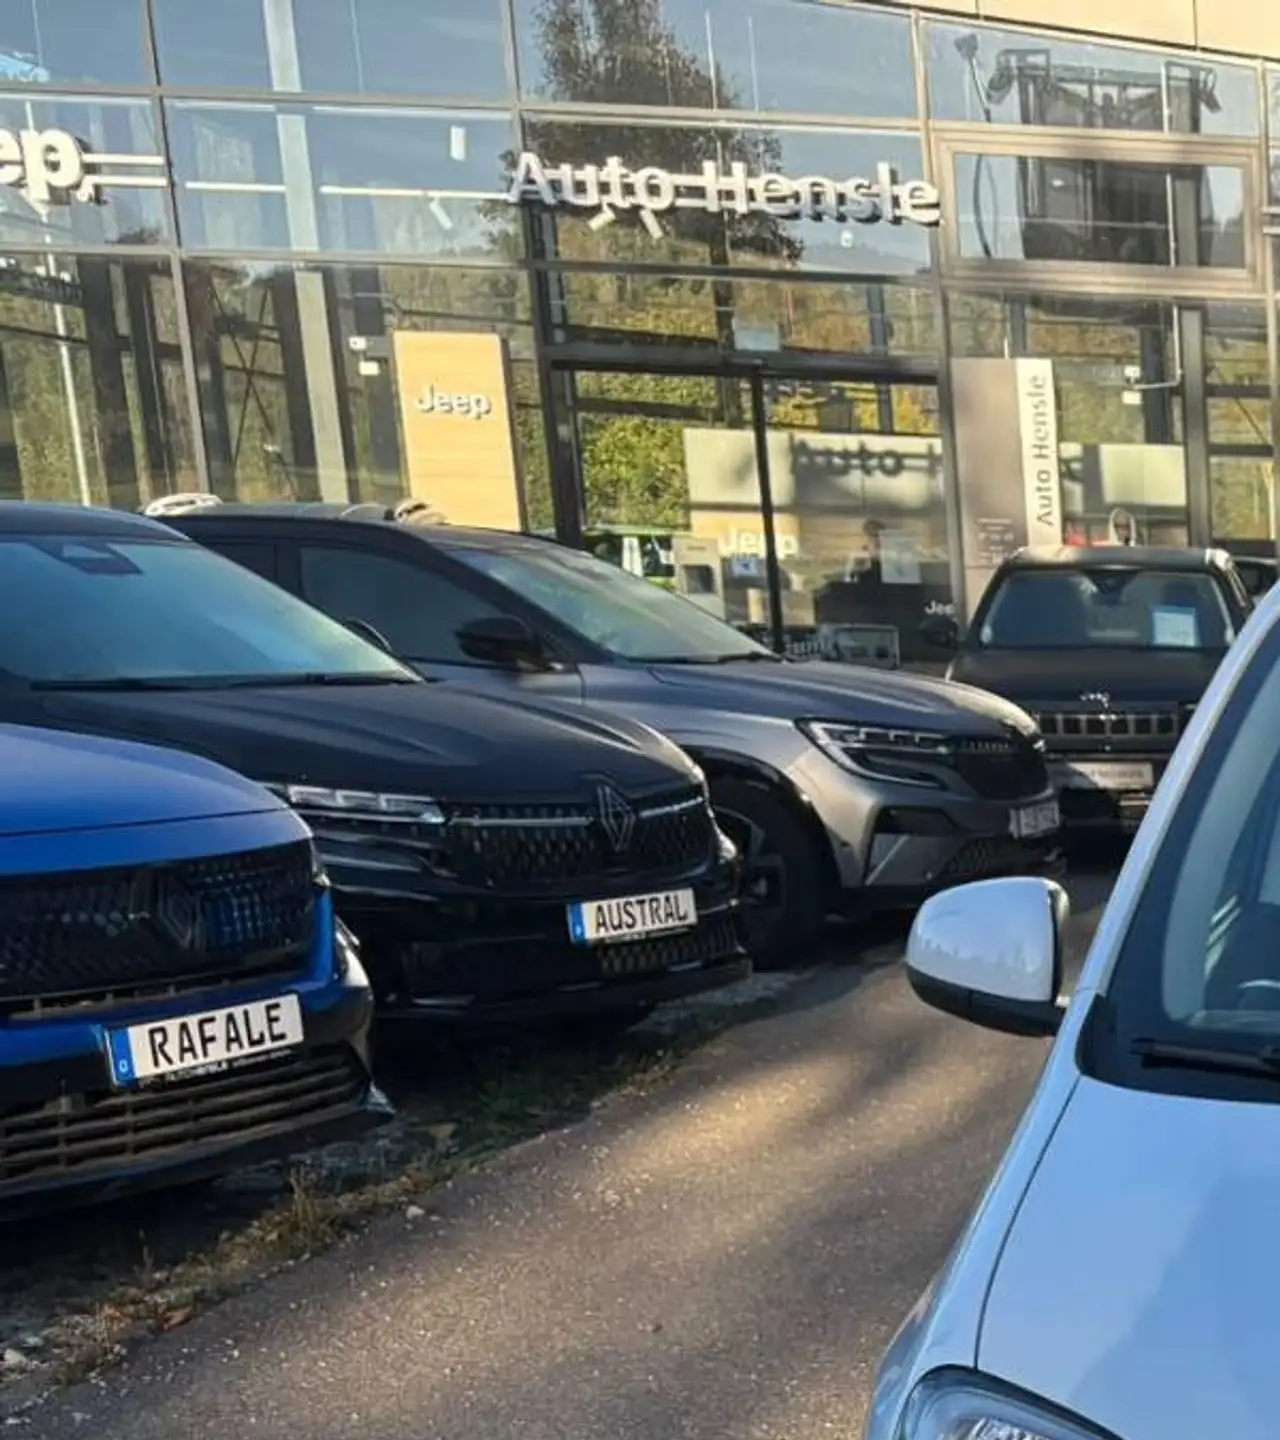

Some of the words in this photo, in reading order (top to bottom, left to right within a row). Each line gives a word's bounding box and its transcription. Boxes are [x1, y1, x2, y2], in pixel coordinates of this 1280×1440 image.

[510, 151, 675, 211] Auto
[701, 160, 940, 224] Hensle
[414, 383, 491, 421] Jeep
[1027, 374, 1051, 460] Hensle
[1035, 469, 1054, 527] Auto
[595, 893, 688, 934] AUSTRAL
[148, 1002, 288, 1068] RAFALE
